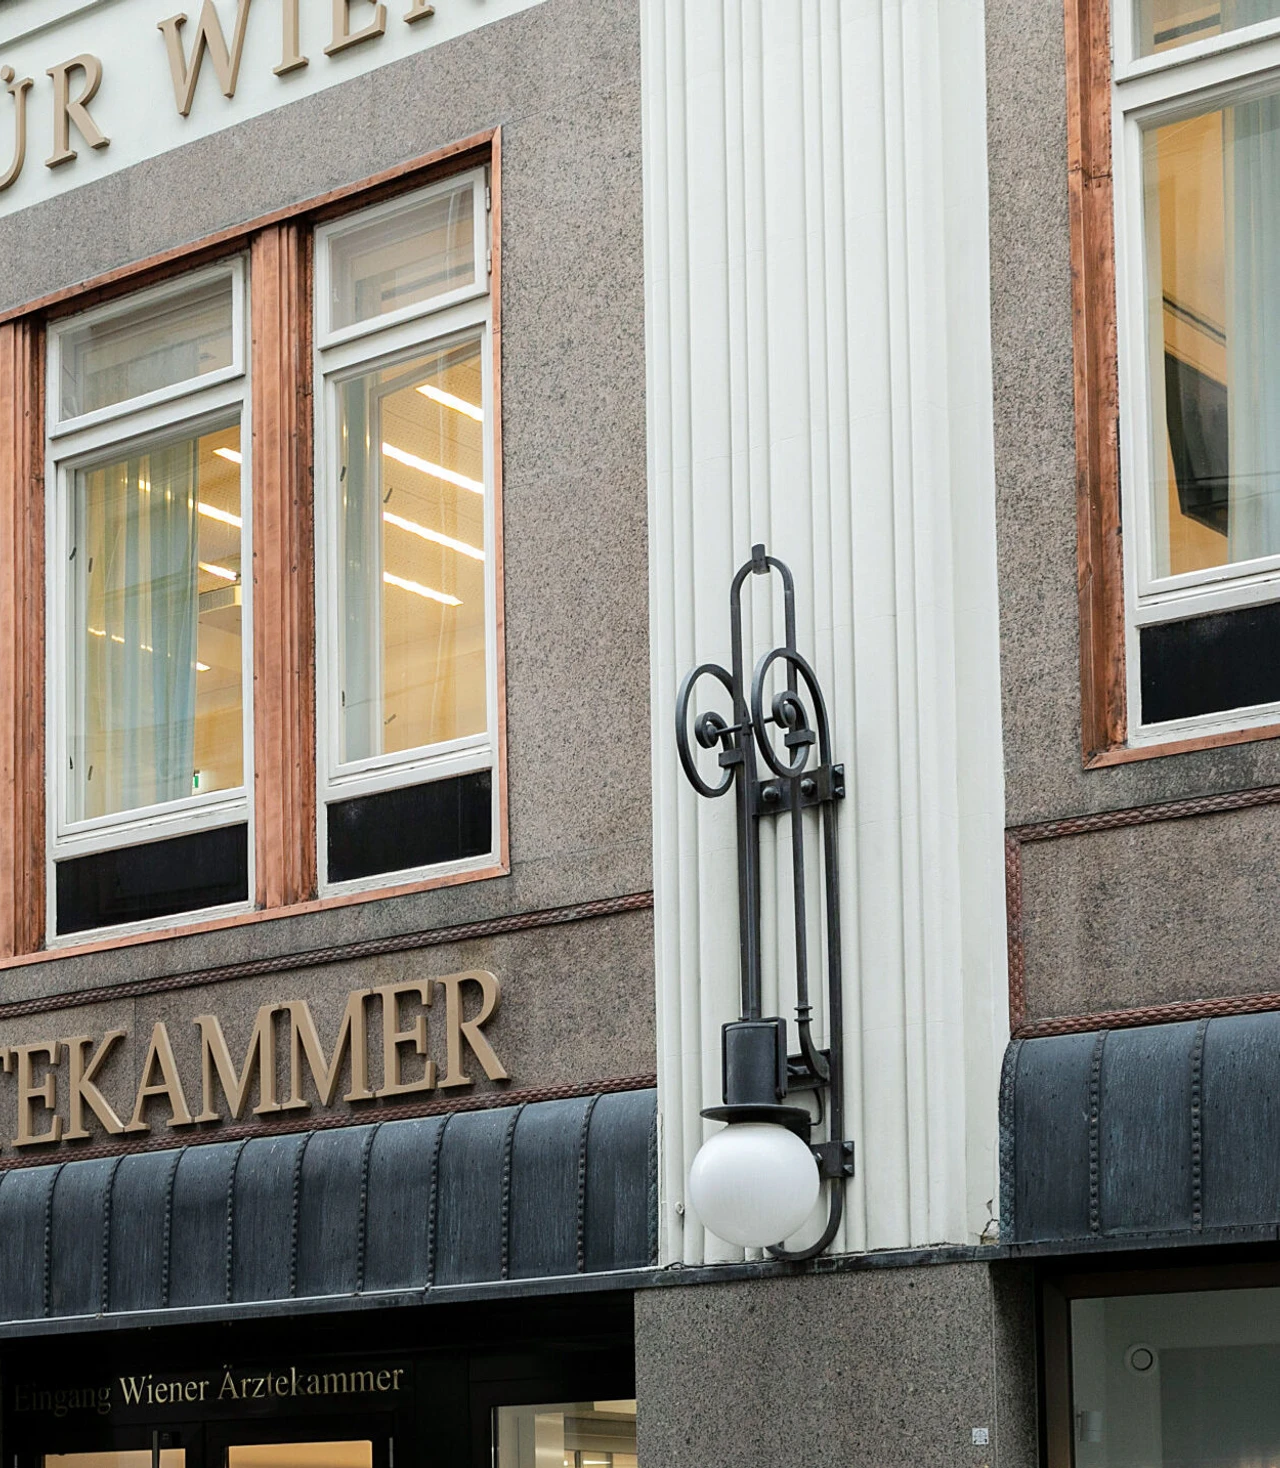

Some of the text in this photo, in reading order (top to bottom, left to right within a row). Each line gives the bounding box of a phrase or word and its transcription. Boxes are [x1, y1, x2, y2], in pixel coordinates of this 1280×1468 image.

[13, 1363, 405, 1416] Eingang Wiener Ärztekammer
